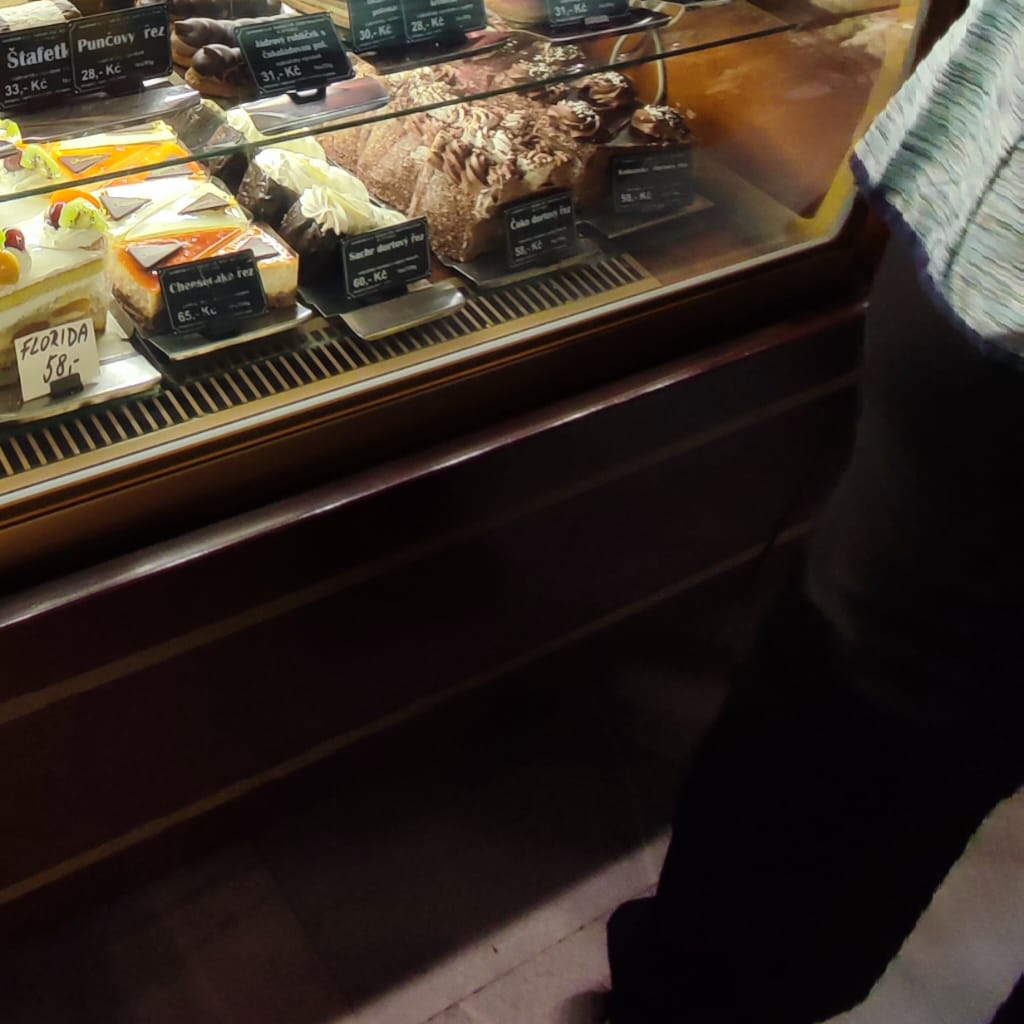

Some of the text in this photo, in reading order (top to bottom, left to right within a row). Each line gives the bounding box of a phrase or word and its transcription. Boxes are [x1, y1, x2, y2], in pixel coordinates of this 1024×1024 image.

[430, 15, 446, 29] Kč
[144, 23, 167, 40] řez
[378, 24, 393, 37] Kč
[81, 62, 123, 83] 28,- Kč
[284, 65, 302, 78] Kč
[4, 77, 49, 98] 33,- Kč
[373, 269, 389, 282] Kč
[20, 322, 89, 361] FLORIDA
